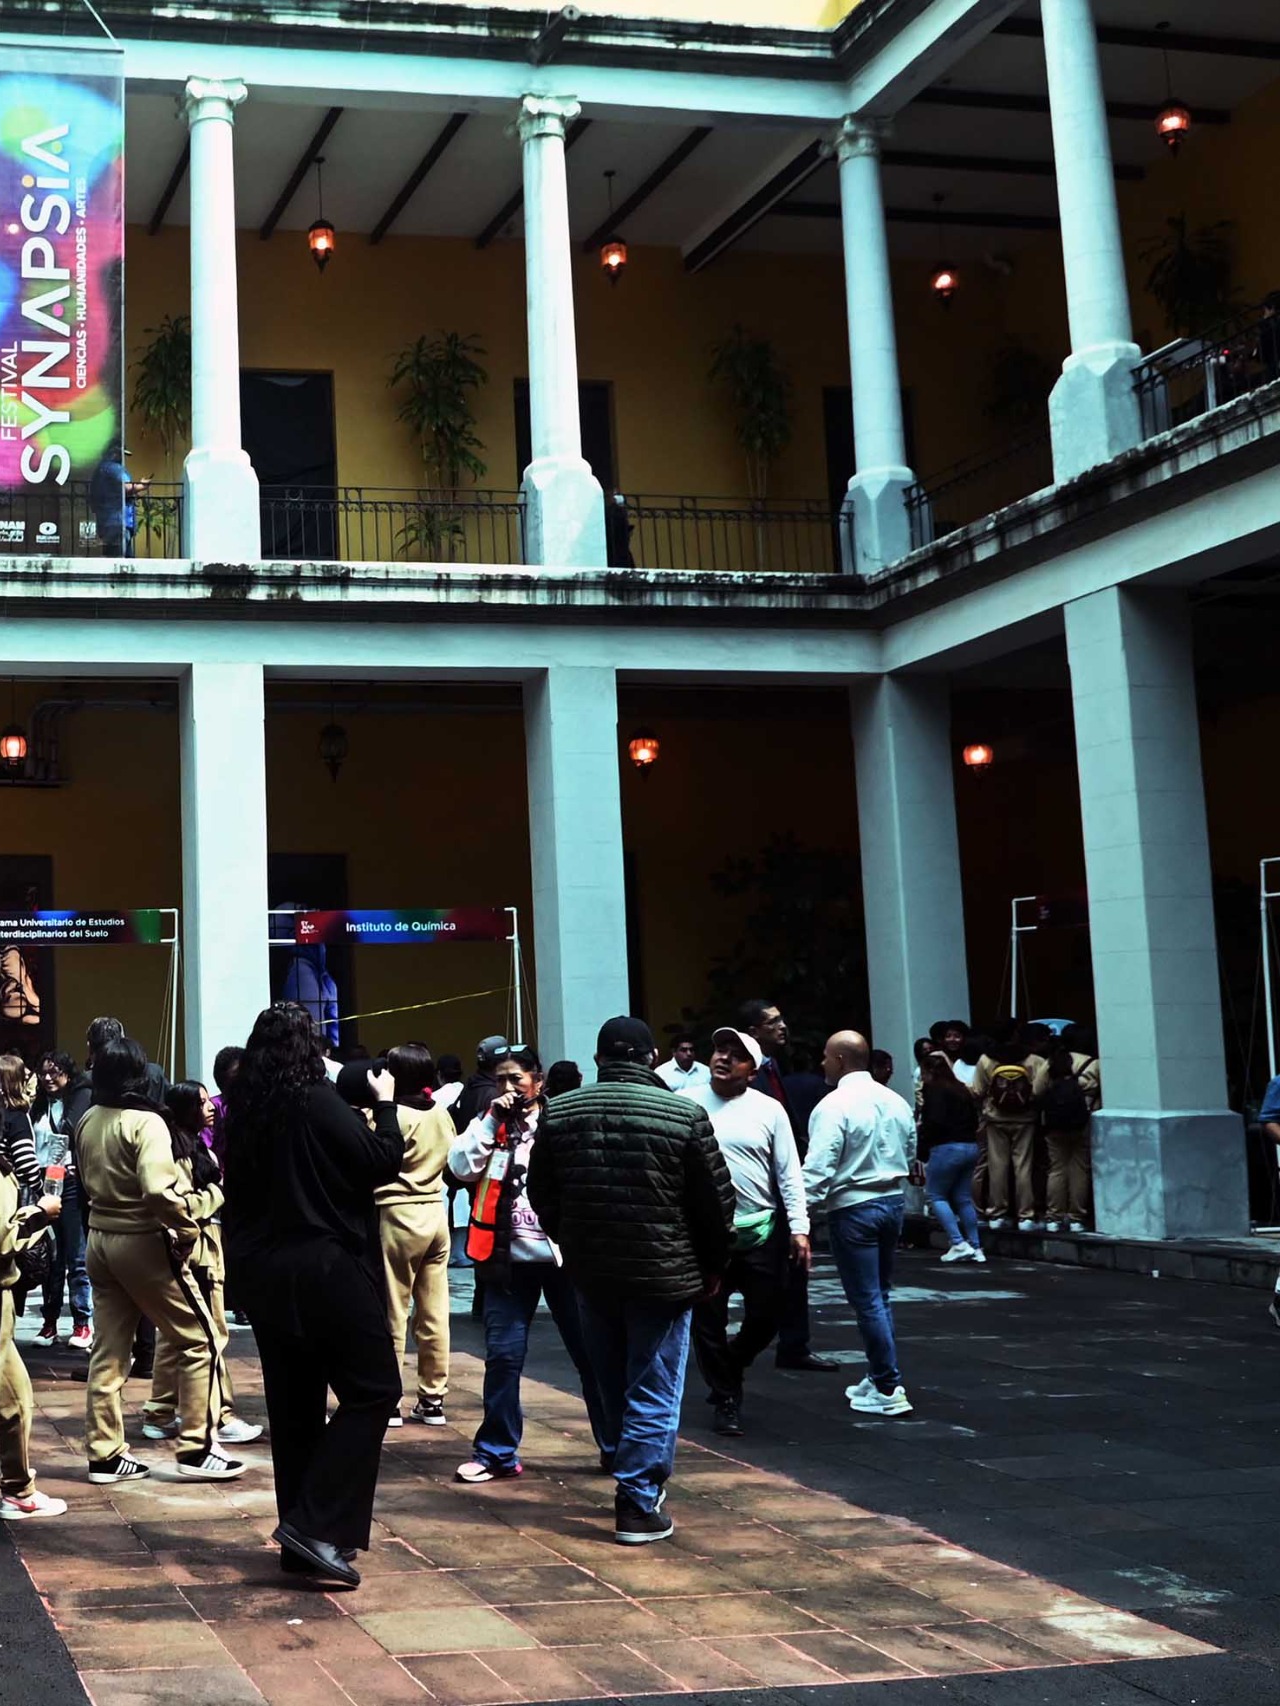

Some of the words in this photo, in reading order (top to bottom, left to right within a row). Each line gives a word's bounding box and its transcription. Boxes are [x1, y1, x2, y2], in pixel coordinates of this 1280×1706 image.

[75, 177, 87, 218] ARTES
[75, 228, 87, 320] HUMANIDADES
[76, 330, 87, 389] CIENCIAS
[1, 341, 18, 441] FESTIVAL
[19, 918, 74, 927] Universitario
[75, 918, 87, 926] de
[88, 917, 125, 926] Estudios
[69, 929, 83, 938] del
[84, 929, 109, 938] Suelo
[345, 921, 392, 932] Instituto
[394, 921, 409, 931] de
[411, 920, 456, 932] Química
